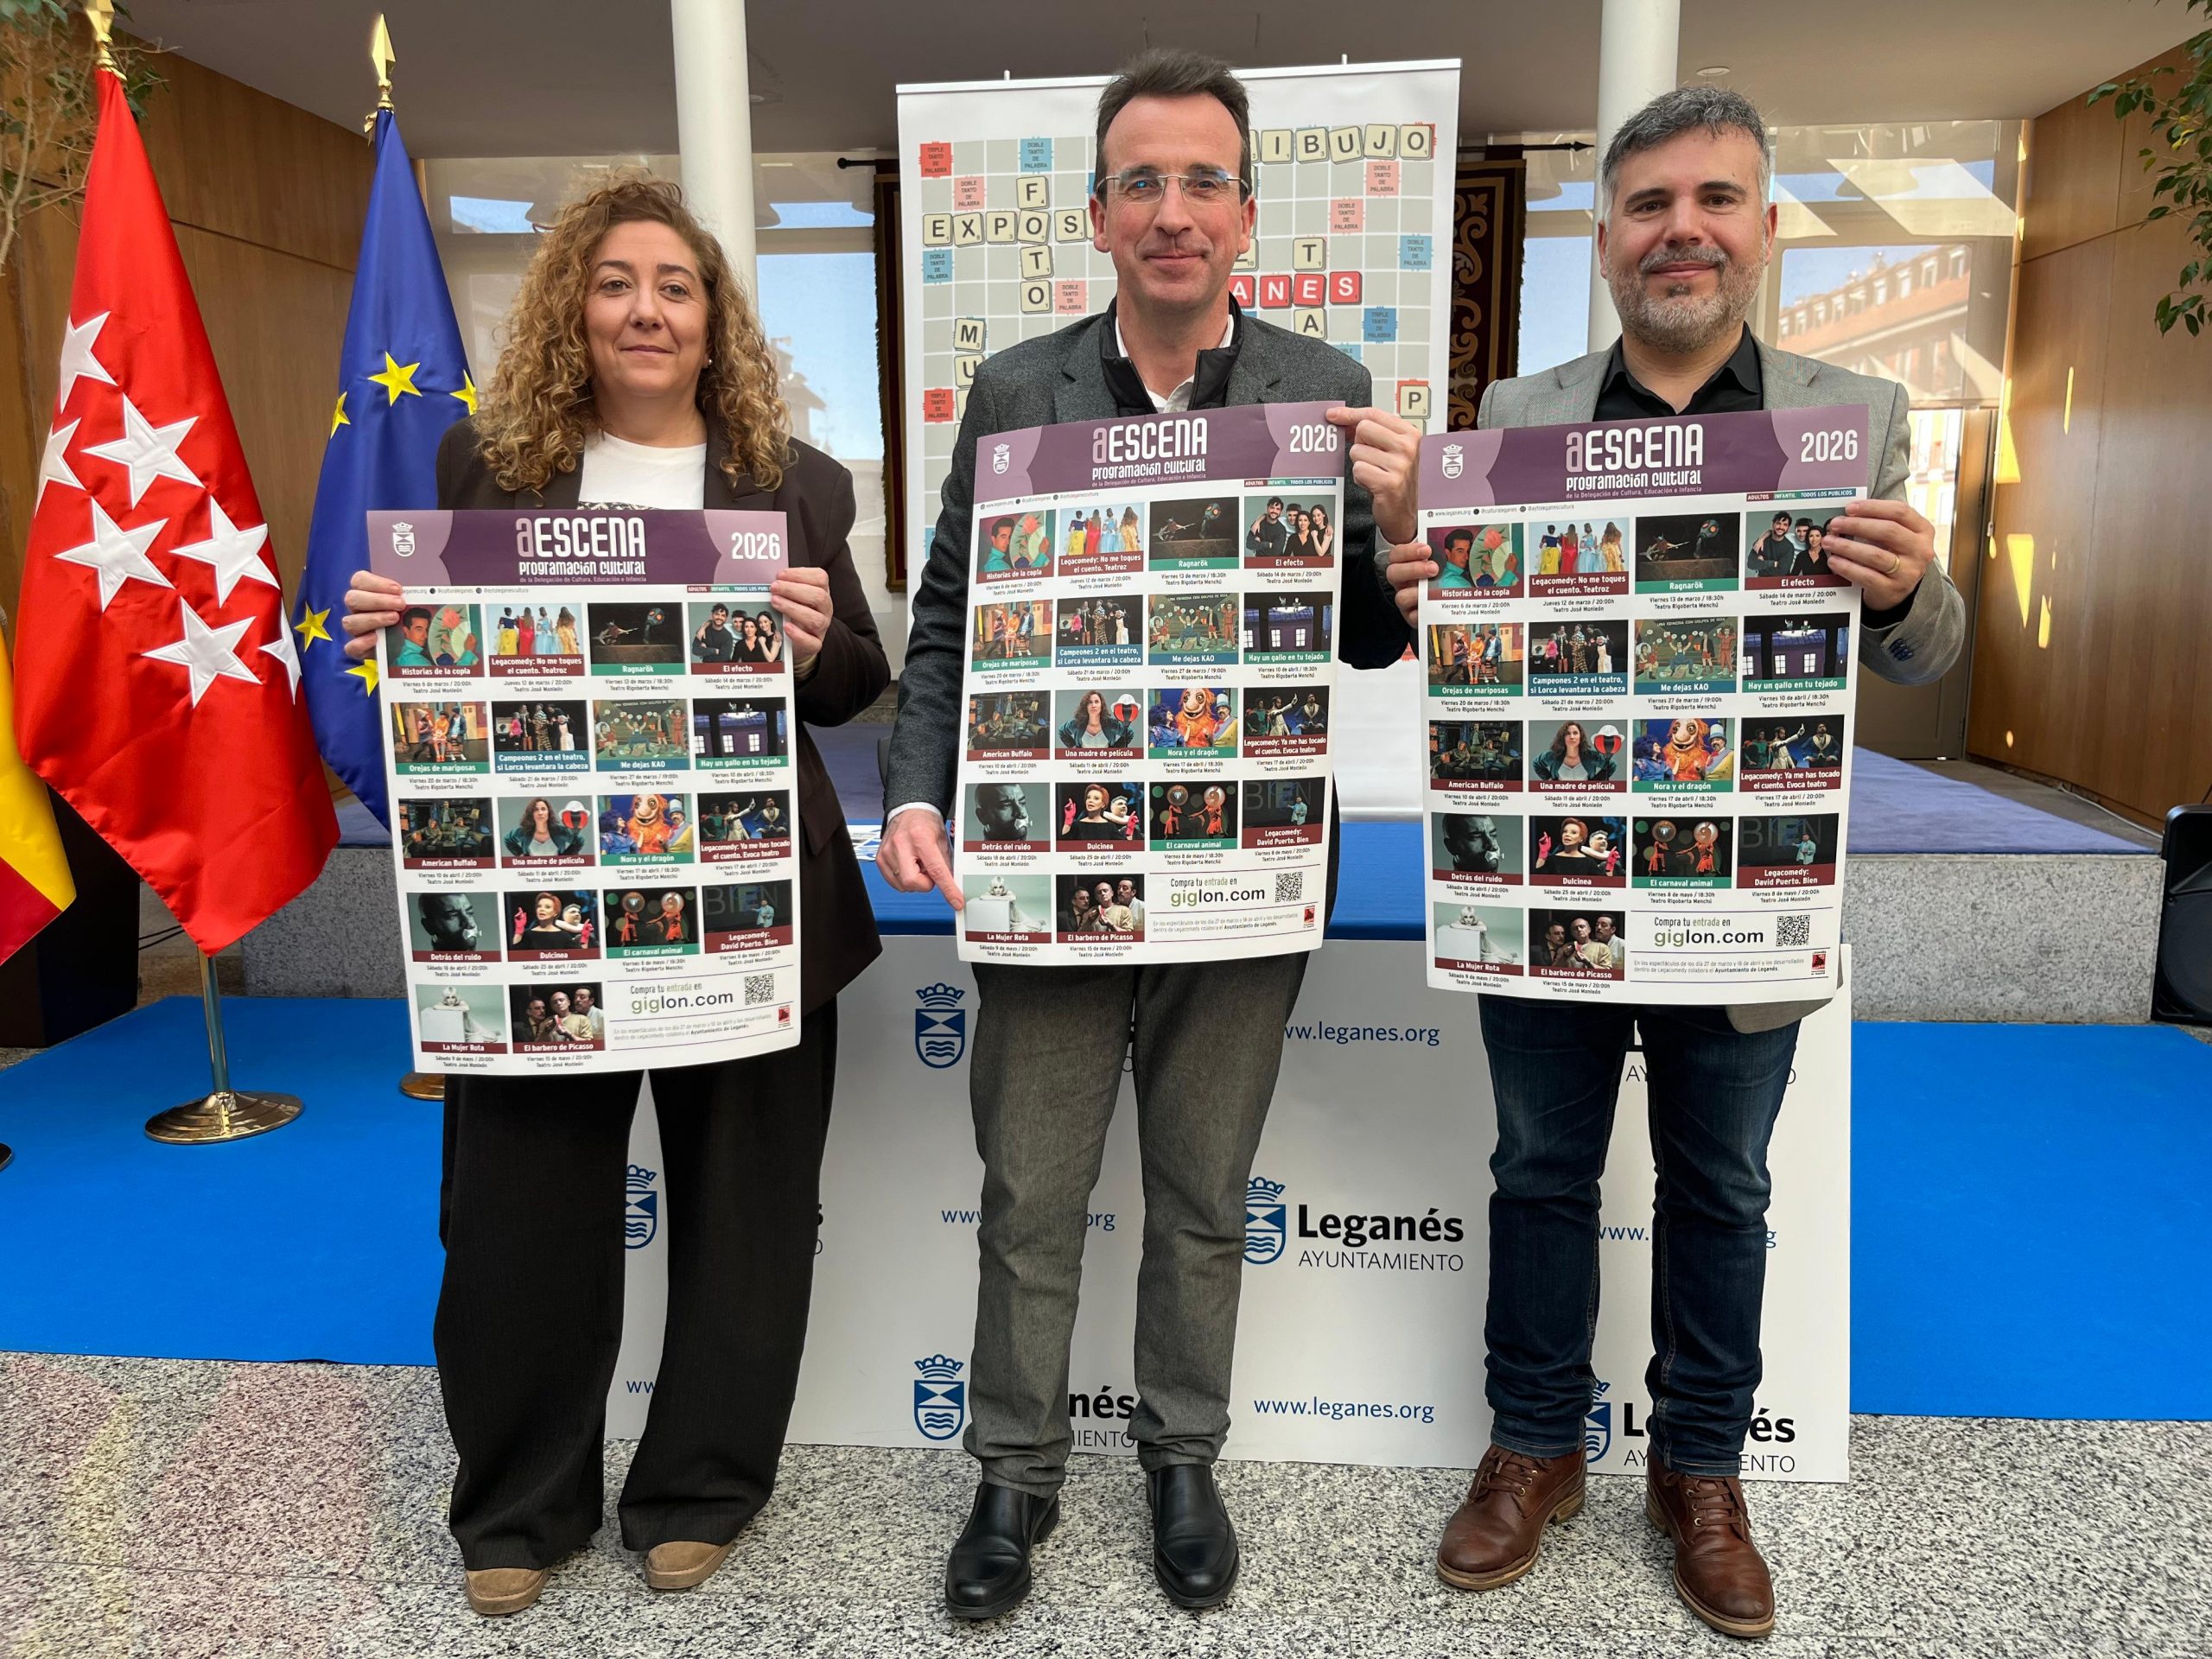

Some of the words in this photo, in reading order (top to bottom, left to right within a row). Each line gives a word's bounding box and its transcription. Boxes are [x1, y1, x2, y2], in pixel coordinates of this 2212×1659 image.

[1274, 130, 1425, 155] IBUJO
[932, 215, 1078, 238] EXPOS
[1025, 182, 1046, 305] FOTO
[1232, 277, 1354, 301] ANES
[1092, 417, 1208, 464] aESCENA
[1290, 424, 1337, 453] 2026
[1566, 423, 1704, 473] aESCENA
[1801, 429, 1858, 462] 2026
[1092, 464, 1161, 481] programación
[1164, 458, 1206, 474] cultural
[1566, 473, 1648, 492] programación
[1651, 469, 1702, 487] cultural
[516, 518, 646, 557] aESCENA
[732, 532, 780, 560] 2026
[519, 562, 597, 575] programación
[600, 562, 646, 575] cultural
[1532, 577, 1577, 586] Legacomedy:
[1669, 582, 1703, 590] Ragnarök
[1673, 683, 1692, 692] dejas
[1109, 749, 1133, 758] película
[1197, 748, 1218, 757] dragón
[1265, 829, 1302, 837] Legacomedy:
[1171, 889, 1265, 907] giglon.com
[1655, 917, 1681, 926] Compra
[1693, 918, 1719, 926] entrada
[1655, 929, 1763, 946] giglon.com
[632, 992, 733, 1014] giglon.com
[1298, 1205, 1464, 1248] Leganés
[1299, 1250, 1464, 1271] AYUNTAMIENTO
[1254, 1396, 1434, 1423] www.leganes.org
